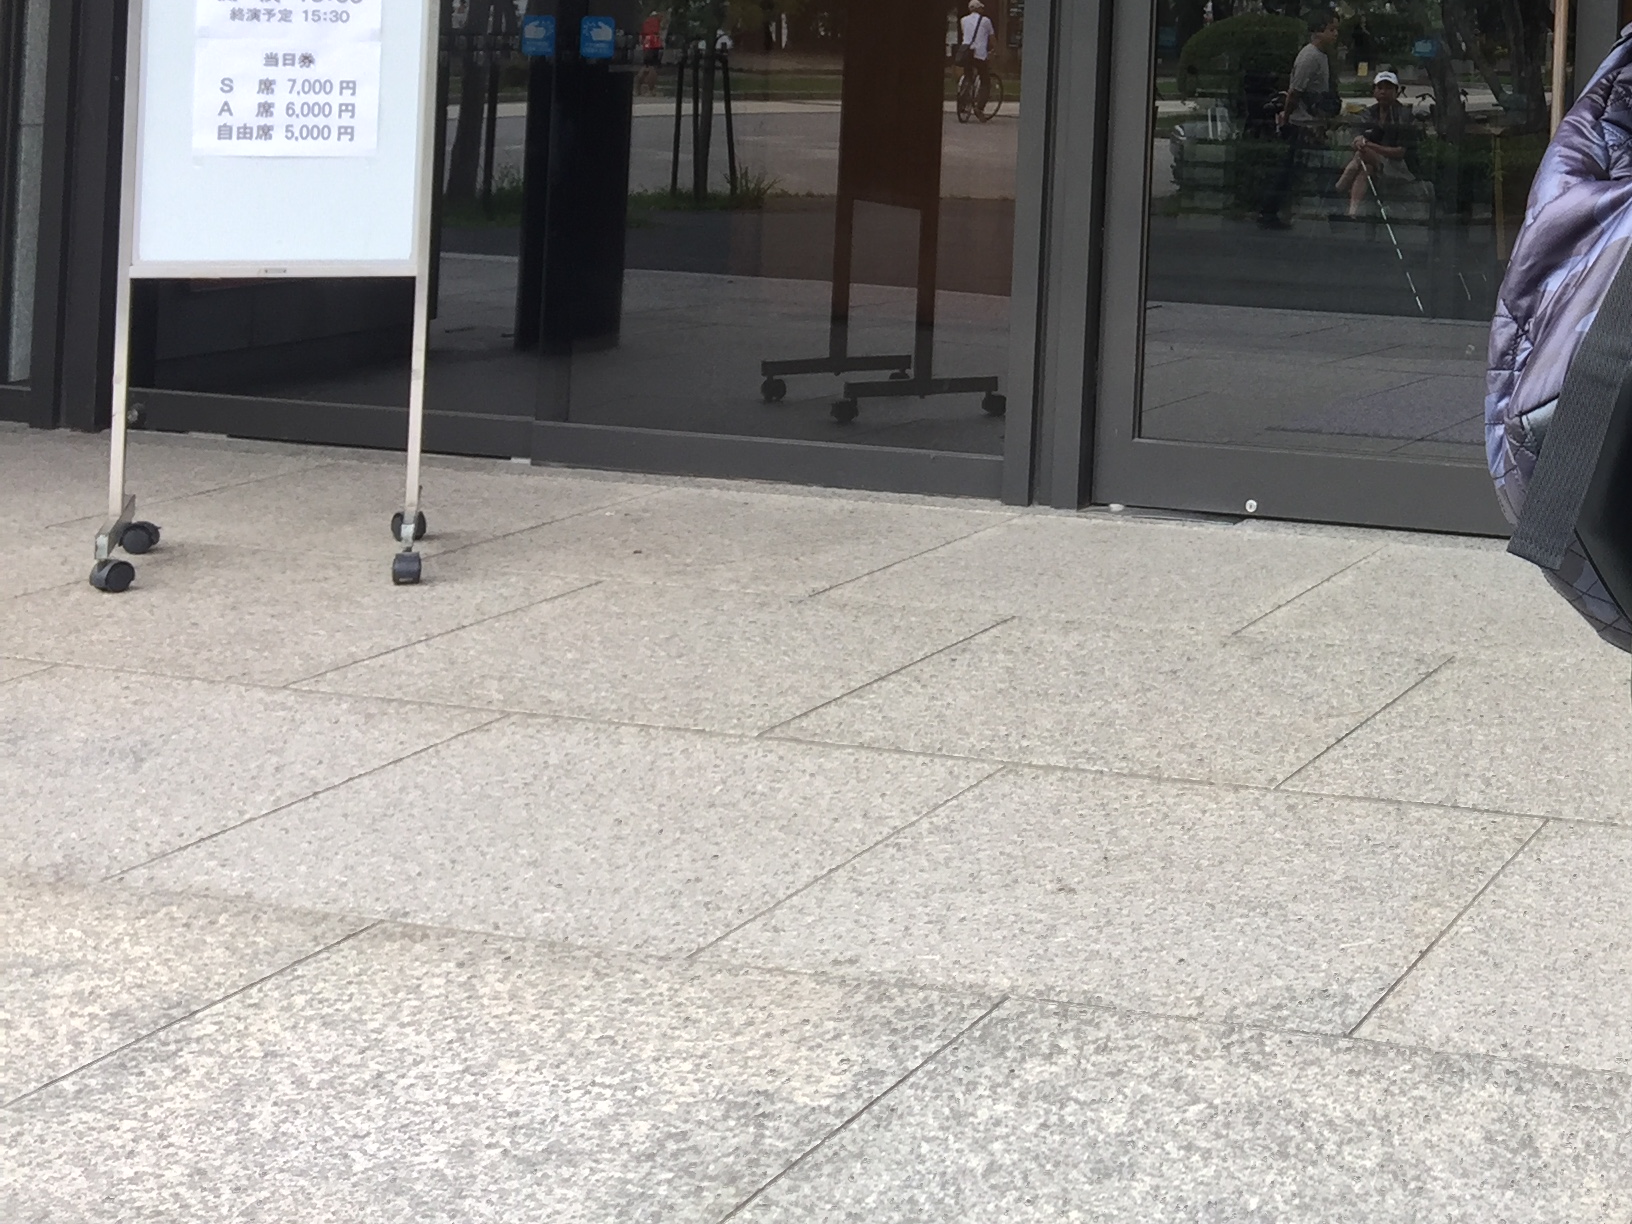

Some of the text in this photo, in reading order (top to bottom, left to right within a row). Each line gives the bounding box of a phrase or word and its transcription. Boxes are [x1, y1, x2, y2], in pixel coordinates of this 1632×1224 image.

[229, 7, 350, 23] 終演予定 15:30
[263, 52, 316, 68] 当日券
[217, 122, 274, 141] 自由席
